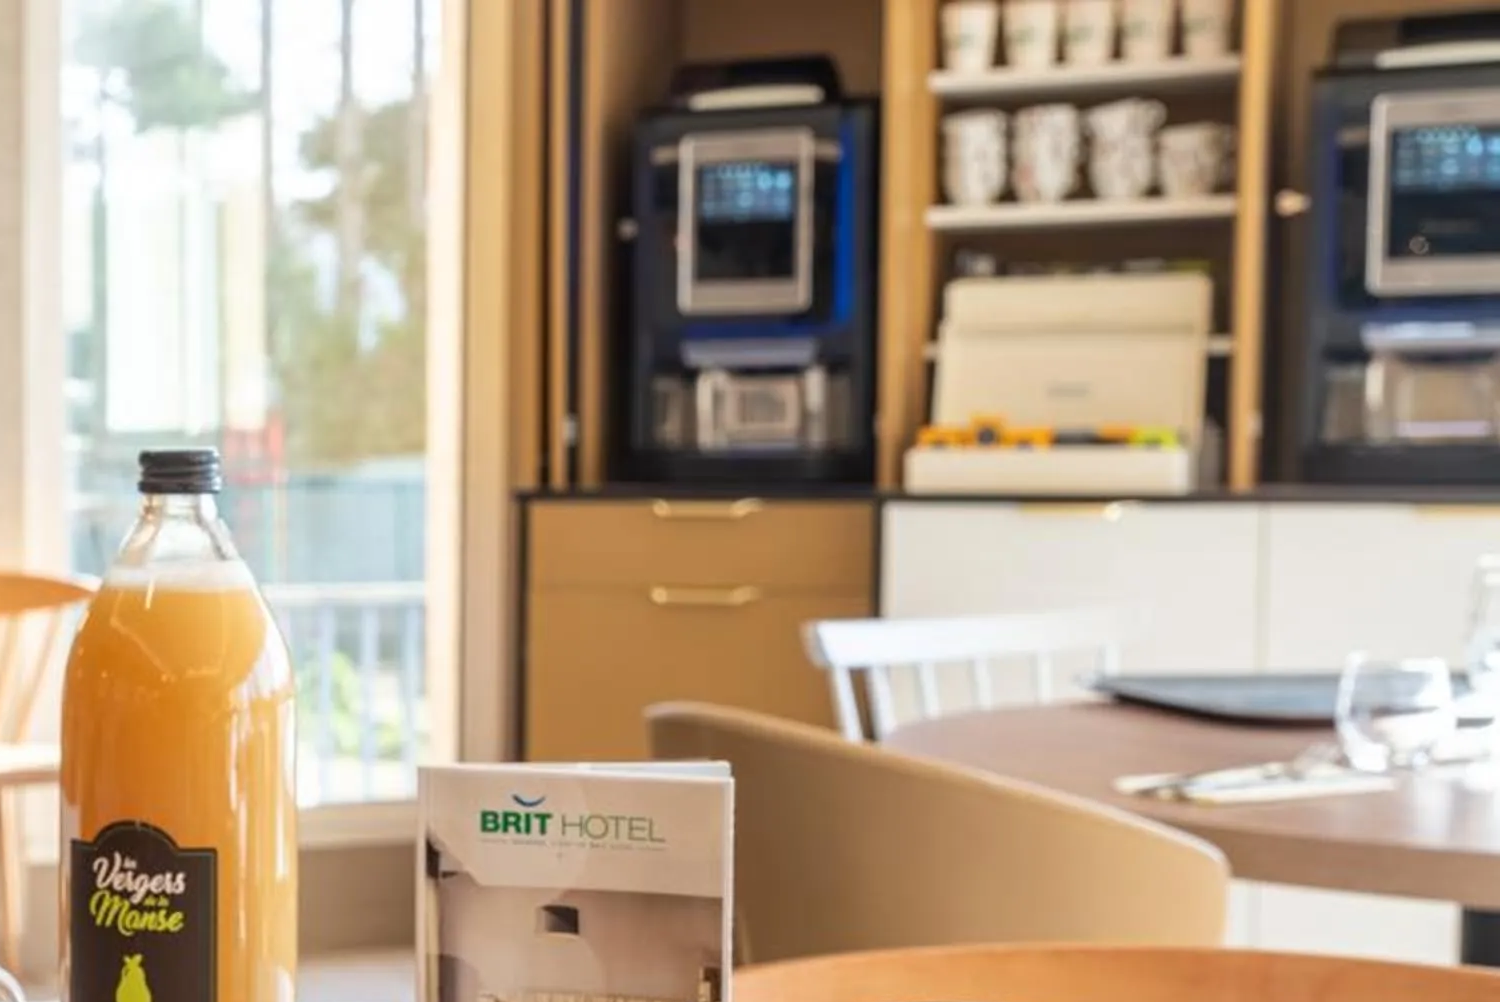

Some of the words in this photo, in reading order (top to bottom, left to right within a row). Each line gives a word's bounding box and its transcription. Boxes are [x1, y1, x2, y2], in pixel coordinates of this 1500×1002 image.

[480, 810, 553, 836] BRIT
[560, 813, 667, 843] HOTEL
[93, 851, 186, 905] Vergers
[90, 889, 185, 936] Manse
